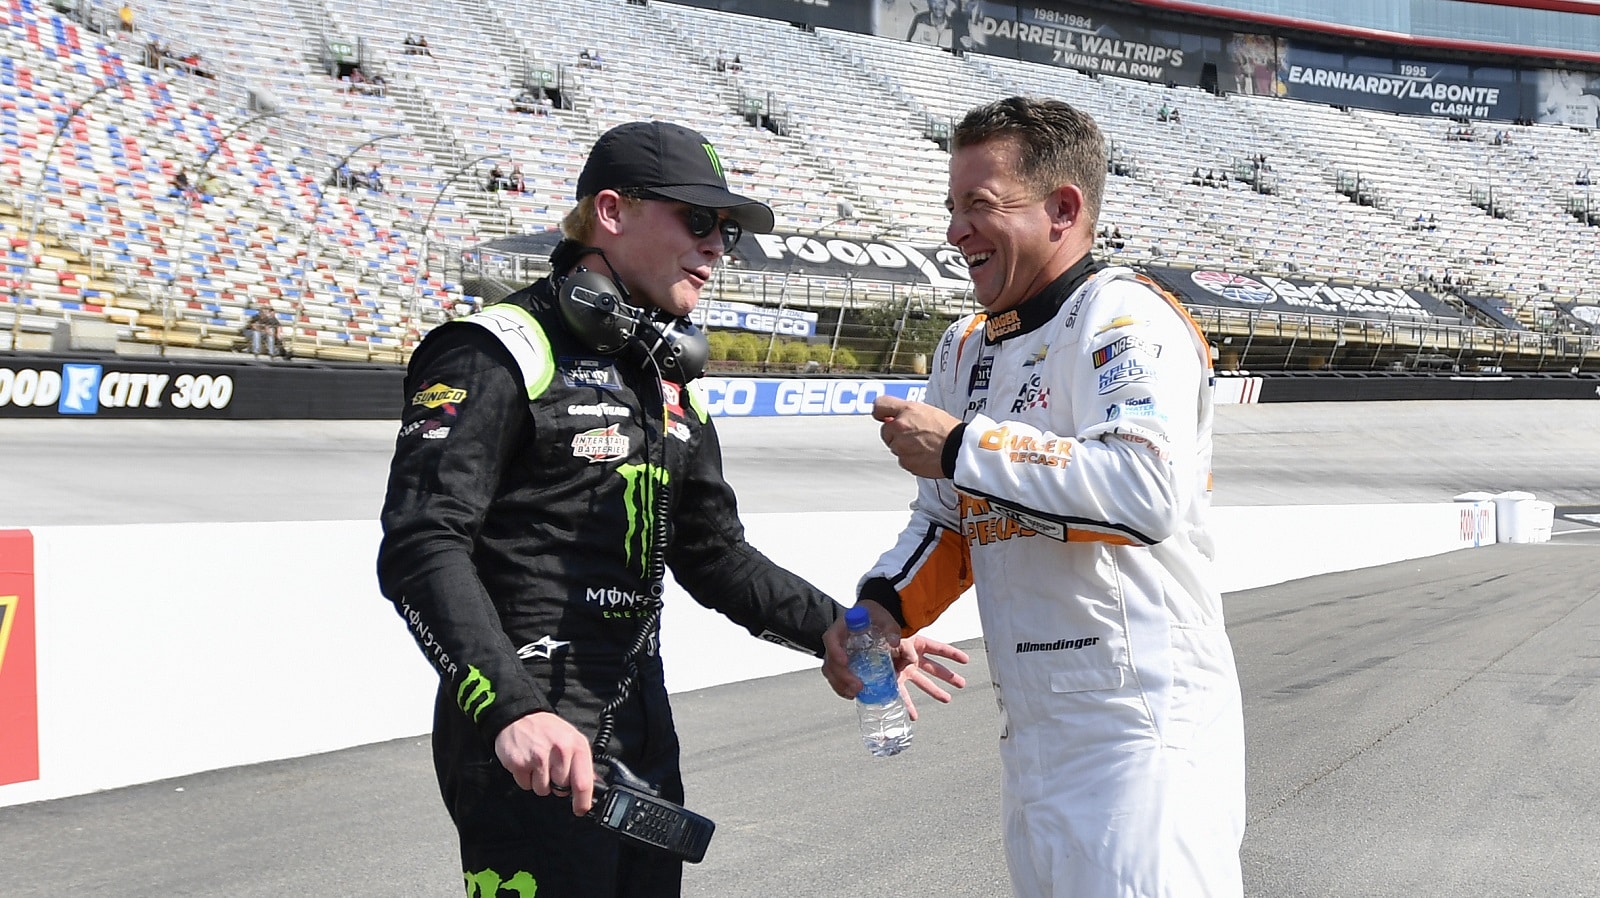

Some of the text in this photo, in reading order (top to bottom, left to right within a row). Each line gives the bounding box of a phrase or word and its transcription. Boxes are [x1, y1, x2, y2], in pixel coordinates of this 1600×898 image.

[1034, 8, 1092, 29] 1981-1984
[983, 16, 1184, 67] DARRELL WALTRIP'S
[1052, 50, 1163, 79] 7 WINS IN A ROW
[1400, 64, 1427, 77] 1995
[1288, 65, 1499, 105] EARNHARDT/LABONTE
[1430, 101, 1489, 117] CLASH #1
[753, 233, 908, 269] FOOD
[1099, 359, 1146, 382] KAUL
[0, 368, 234, 409] OOD CITY 300
[413, 389, 465, 404] SUNOCO
[774, 380, 886, 415] GEICO
[577, 445, 625, 454] BATTERIES
[1008, 451, 1072, 470] RECAST
[1016, 637, 1100, 654] Allmendinger
